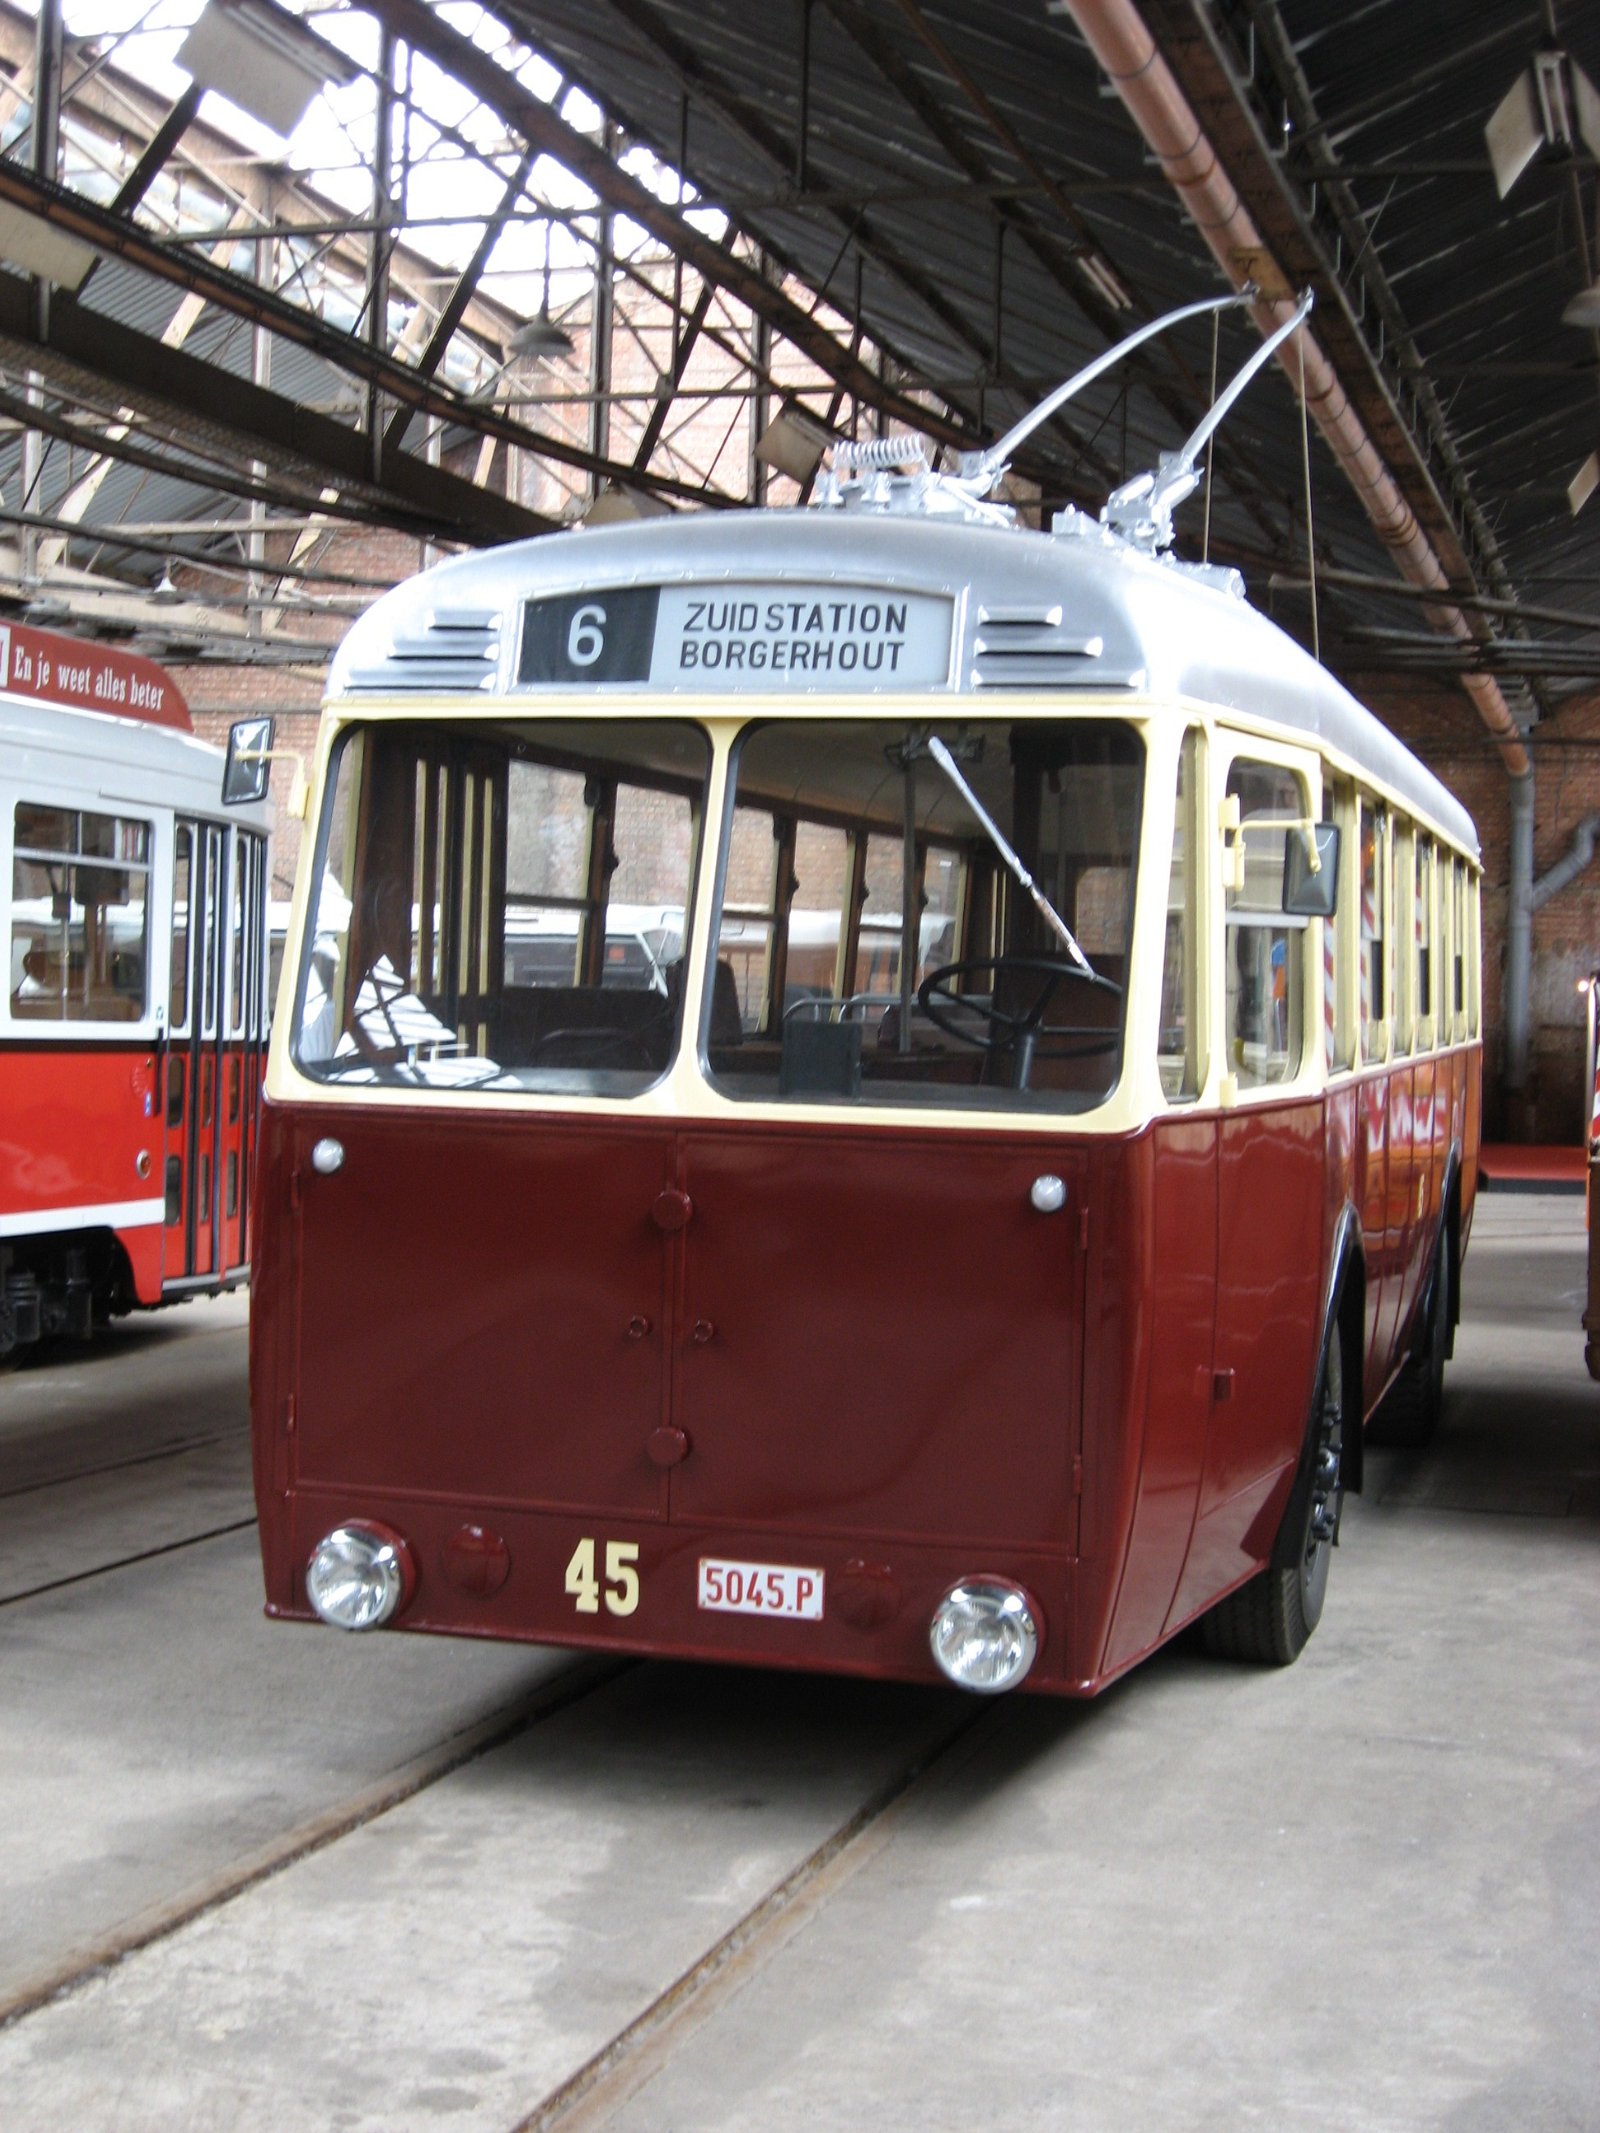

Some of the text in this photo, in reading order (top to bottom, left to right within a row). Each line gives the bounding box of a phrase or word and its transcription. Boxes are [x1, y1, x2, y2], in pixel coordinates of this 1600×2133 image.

[567, 604, 607, 666] 6
[679, 639, 904, 671] BORGERHOUT
[14, 645, 32, 681] En
[36, 651, 51, 690] je
[58, 664, 91, 695] weet
[95, 666, 127, 703] alles
[129, 673, 165, 712] beter
[565, 1538, 640, 1616] 45
[705, 1567, 813, 1612] 5045.P
